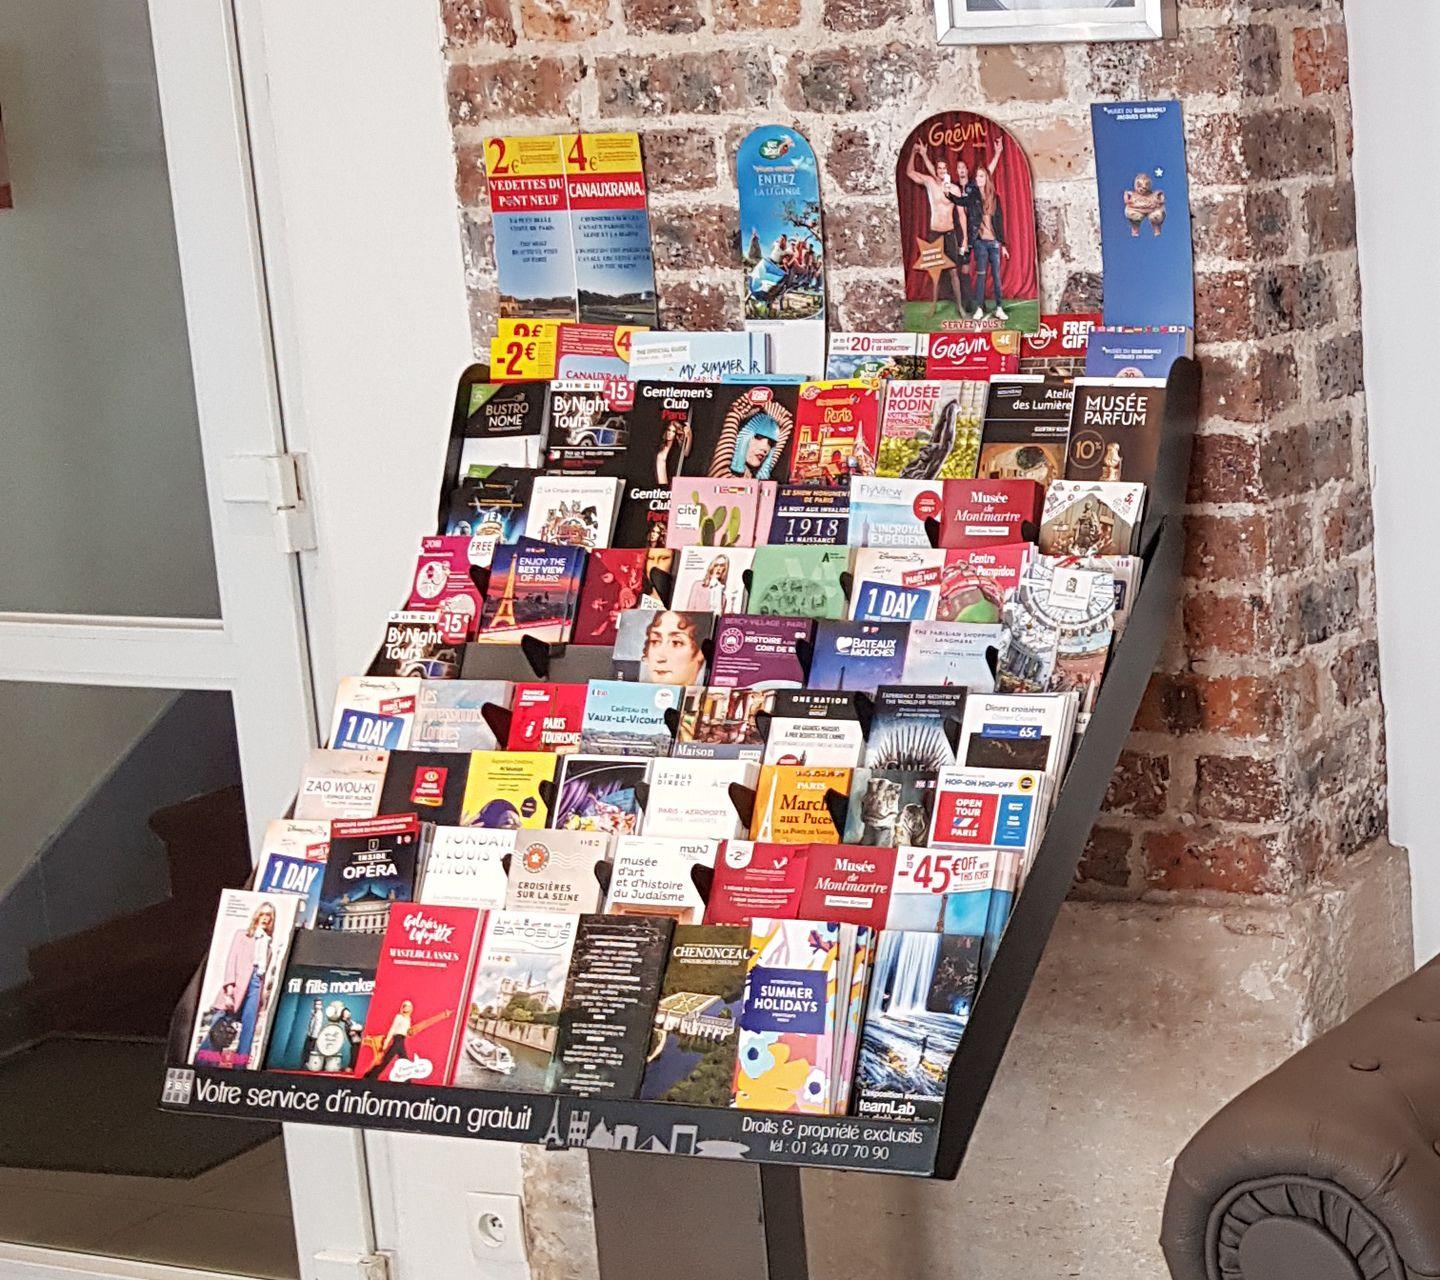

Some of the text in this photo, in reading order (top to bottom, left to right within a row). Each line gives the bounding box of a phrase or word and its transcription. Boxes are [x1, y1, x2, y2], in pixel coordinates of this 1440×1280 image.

[489, 177, 564, 192] VEDETTES DU
[530, 194, 560, 206] NEUF
[701, 358, 744, 375] SUMMER
[643, 385, 713, 399] Gentlemen's
[889, 384, 941, 398] MUSÉE
[553, 395, 609, 415] By Night
[663, 397, 689, 410] Club
[888, 399, 934, 412] RODIN
[1013, 399, 1030, 410] des
[1085, 393, 1148, 412] MUSÉE
[488, 413, 523, 427] NOME
[552, 413, 592, 428] Tours
[824, 407, 853, 423] Paris
[1083, 411, 1146, 426] PARFUM
[970, 491, 1009, 504] Musée
[954, 509, 1021, 522] Montmartre
[786, 518, 839, 536] 1918
[471, 541, 493, 551] FREE
[519, 557, 567, 566] ENJOY THE
[969, 553, 996, 564] Centre
[517, 565, 565, 575] BEST VIEW
[521, 574, 560, 582] OF PARIS
[868, 588, 920, 619] 1 DAY
[387, 626, 443, 647] By Night
[851, 638, 896, 649] BATEAUX
[385, 644, 422, 660] Tours
[850, 647, 895, 657] MOUCHES
[792, 695, 849, 704] ONE NATION
[541, 717, 567, 729] PARIS
[346, 715, 394, 746] 1 DAY
[541, 730, 582, 744] TOURISME
[676, 744, 714, 757] Maison
[306, 780, 376, 793] ZAO WOU-KI
[657, 779, 692, 787] DIRECT
[944, 778, 977, 787] HOP-ON
[955, 798, 982, 807] OPEN
[779, 813, 833, 825] aux Puces
[954, 808, 981, 817] TOUR
[950, 828, 978, 837] PARIS
[620, 856, 658, 867] musée
[834, 857, 876, 873] Musée
[961, 856, 978, 871] OFF
[271, 862, 318, 892] 1 DAY
[342, 862, 398, 880] OPÉRA
[618, 867, 644, 877] d'art
[847, 873, 859, 882] de
[517, 880, 572, 891] CROISIÈRES
[615, 878, 683, 891] et d'histoire
[814, 877, 888, 895] Montmartre
[516, 890, 534, 899] SUR
[551, 893, 580, 902] SEINE
[613, 889, 628, 899] du
[493, 925, 571, 940] BATOBUS
[760, 985, 813, 1000] SUMMER
[754, 998, 818, 1013] HOLIDAYS
[196, 1077, 532, 1133] Votre service d'information gratuit
[859, 1099, 916, 1116] teamLab
[741, 1117, 923, 1144] Droits & propriété exclusifs
[791, 1142, 807, 1155] 01
[811, 1144, 828, 1157] 34
[832, 1145, 850, 1157] 07
[852, 1146, 870, 1159] 70
[872, 1147, 890, 1160] 90
